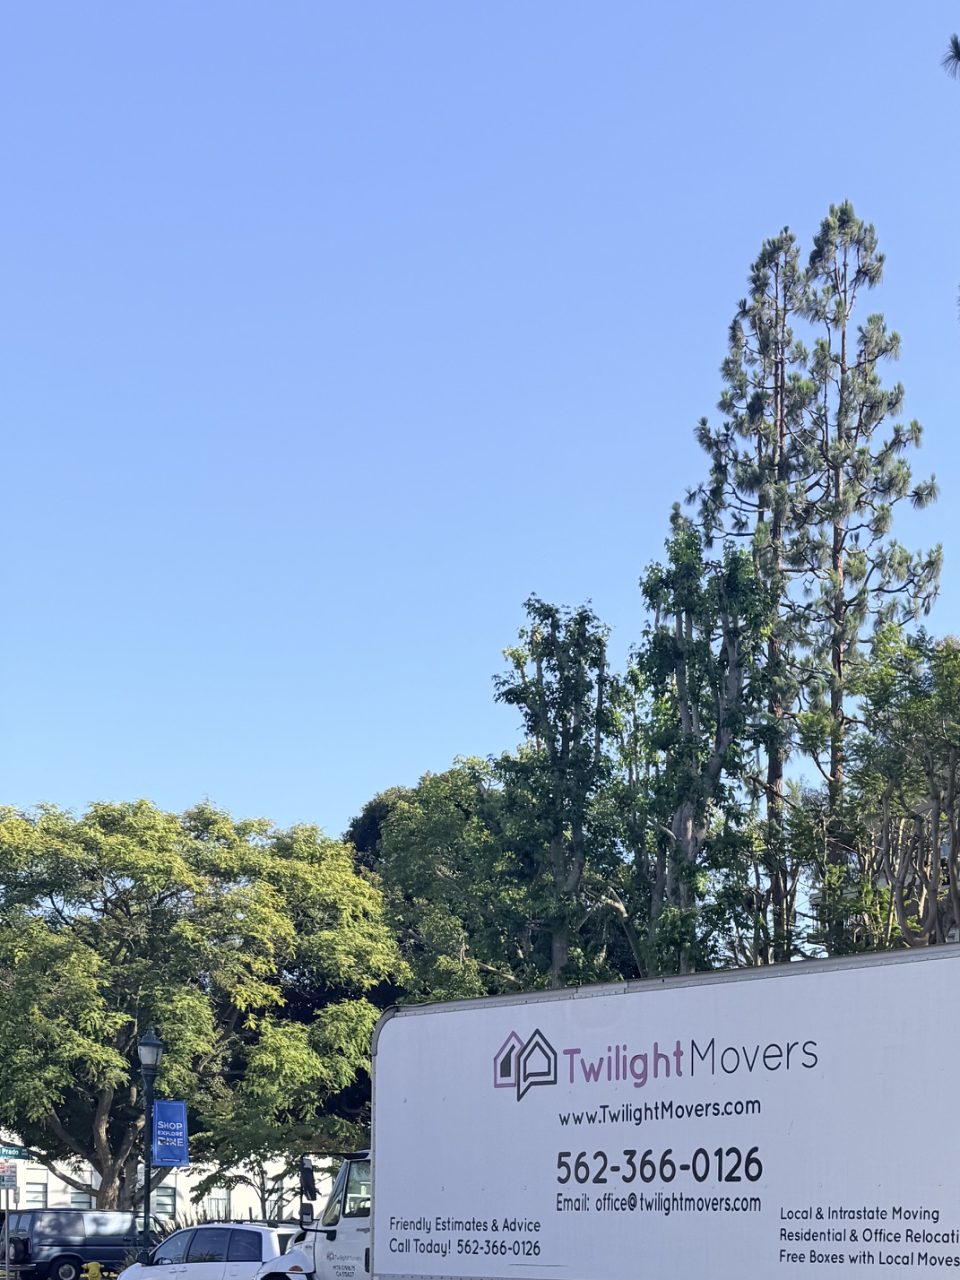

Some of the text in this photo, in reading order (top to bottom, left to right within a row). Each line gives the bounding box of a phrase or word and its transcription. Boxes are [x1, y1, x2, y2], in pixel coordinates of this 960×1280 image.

[558, 1099, 761, 1126] www.TwilightMovers.com
[157, 1120, 182, 1130] SHOP
[157, 1129, 183, 1137] EXPLORE
[157, 1136, 184, 1147] DINE
[556, 1146, 763, 1184] 562-366-0126
[556, 1193, 590, 1211] Email:
[780, 1206, 940, 1223] Local & Intrastate Moving
[389, 1216, 541, 1234] Friendly Estimates & Advice
[780, 1228, 846, 1242] Residential
[849, 1229, 859, 1242] &
[862, 1228, 901, 1242] Office
[389, 1238, 541, 1257] Call Today! 562-366-0126
[779, 1249, 960, 1267] Free Boxes with Local Moves
